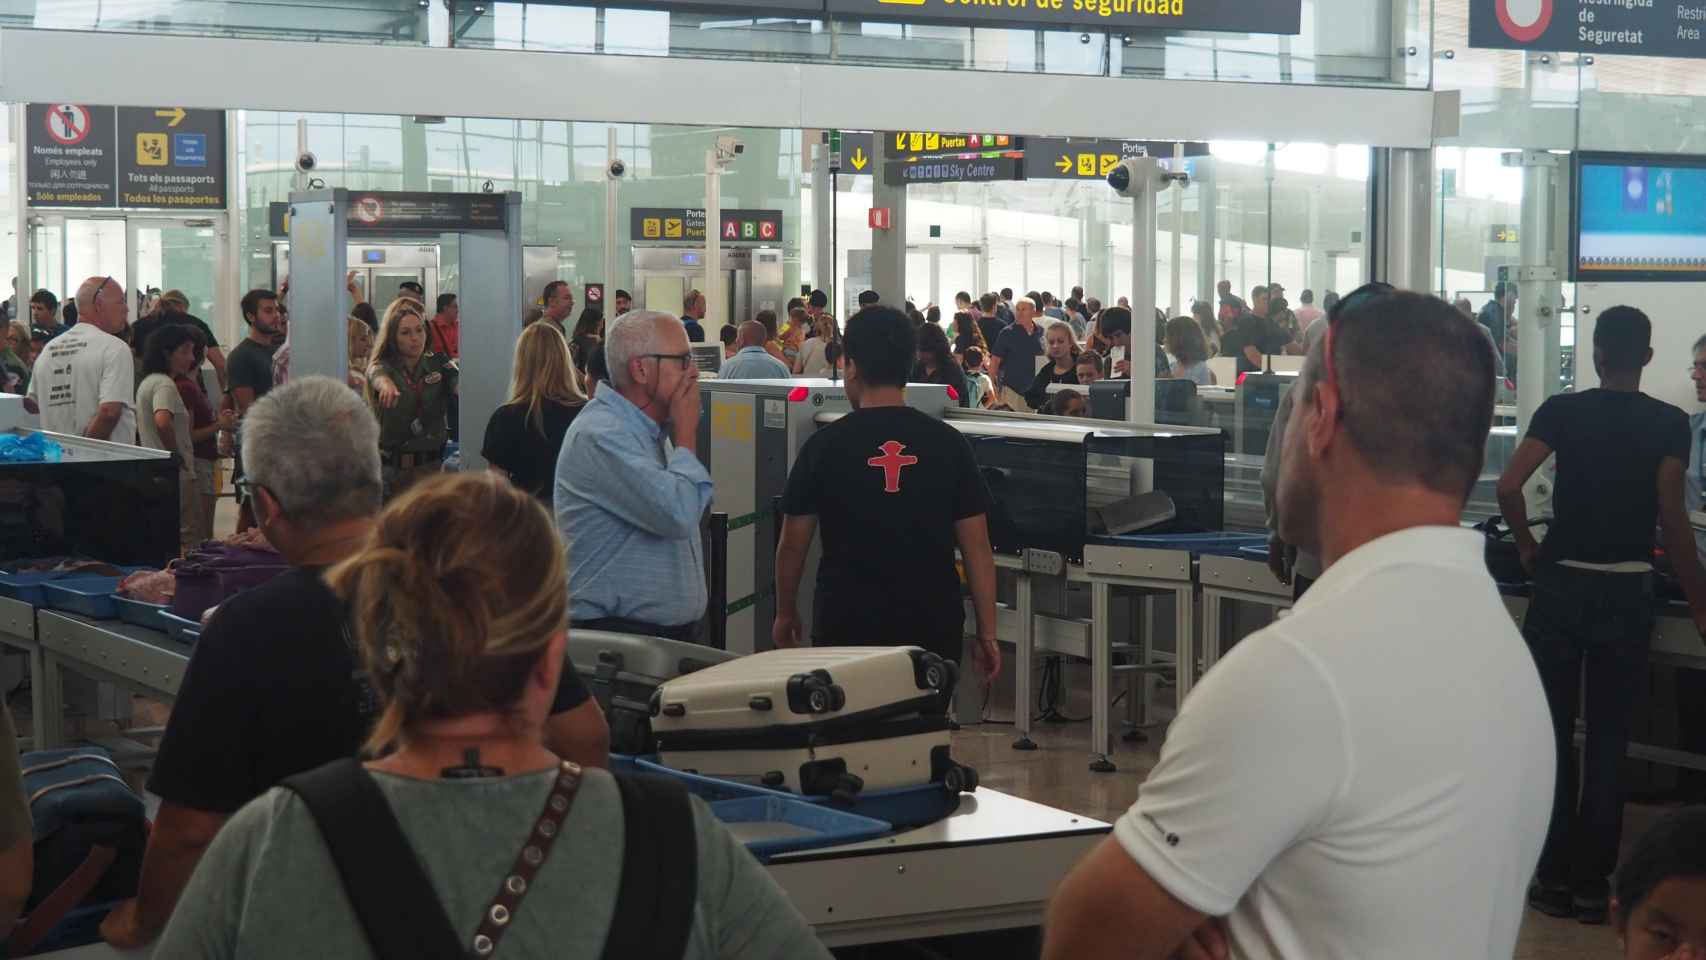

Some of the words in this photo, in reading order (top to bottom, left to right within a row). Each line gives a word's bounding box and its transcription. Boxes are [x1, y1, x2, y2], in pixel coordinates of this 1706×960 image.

[1578, 7, 1595, 22] de
[1578, 26, 1644, 45] Seguretat
[1677, 25, 1700, 40] Area
[941, 136, 966, 148] Puertas
[33, 145, 63, 155] Només
[65, 146, 103, 156] empleats
[127, 172, 148, 183] Tots
[149, 173, 163, 183] els
[164, 175, 215, 184] passaports
[950, 164, 965, 180] Sky
[967, 163, 995, 177] Centre
[124, 193, 152, 203] Todos
[152, 194, 167, 203] los
[167, 195, 220, 205] pasaportes
[726, 222, 736, 237] A
[744, 222, 754, 237] B
[762, 222, 772, 237] C
